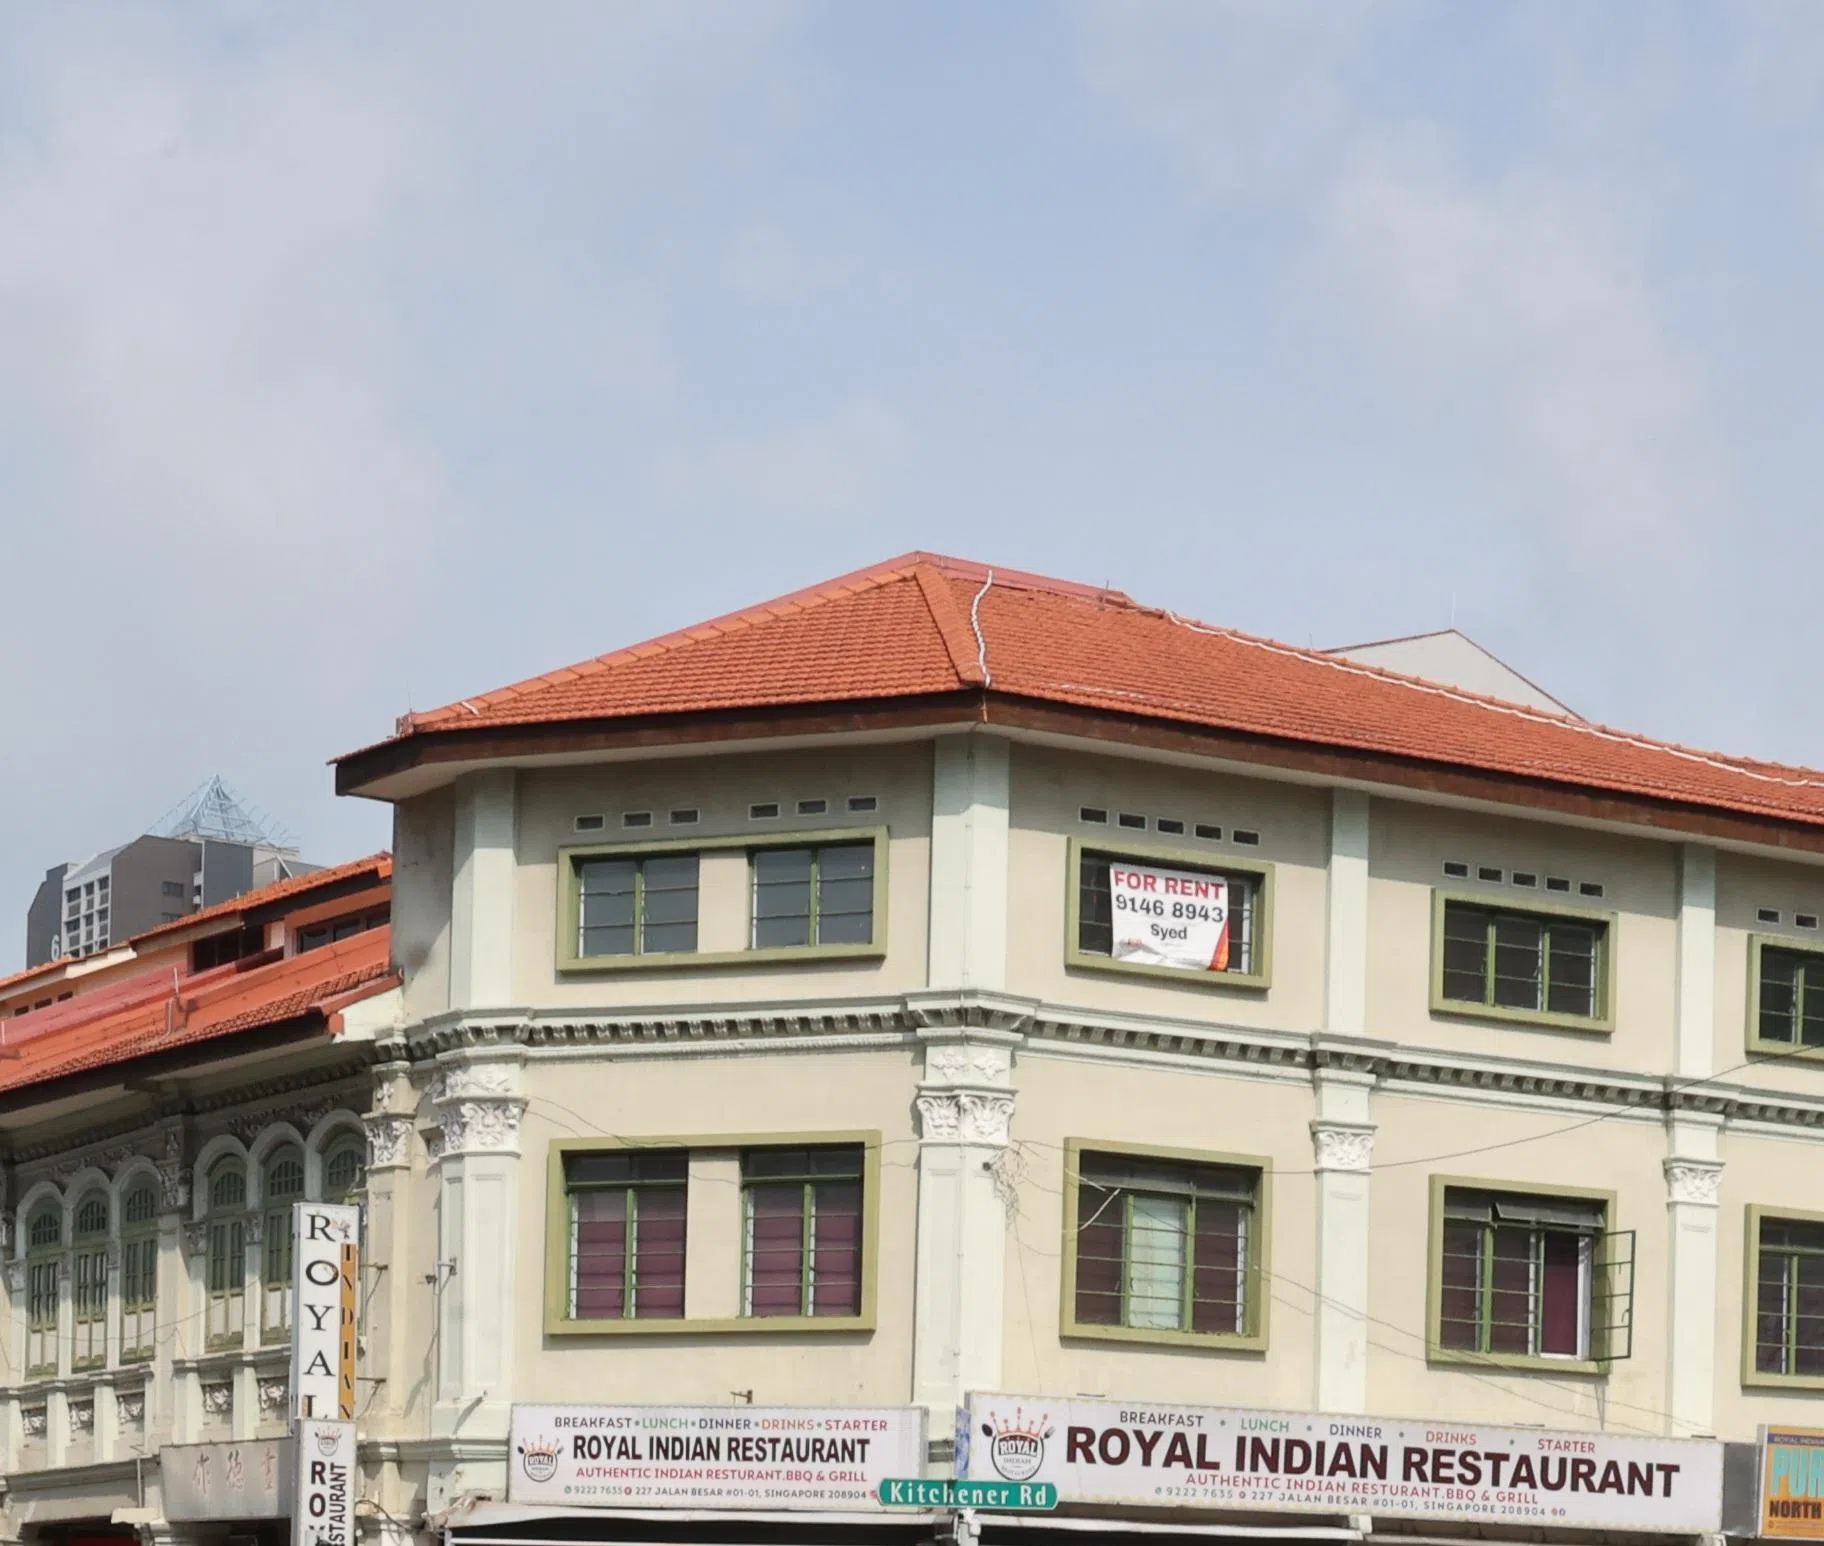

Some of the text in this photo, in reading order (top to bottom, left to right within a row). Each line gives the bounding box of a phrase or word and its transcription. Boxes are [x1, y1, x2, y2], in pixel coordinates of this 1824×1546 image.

[1114, 870, 1224, 899] FOR RENT
[1116, 894, 1223, 923] 9146 8943
[1151, 924, 1187, 941] Syed
[555, 1417, 888, 1431] BREAKFAST LUNCH DINNER DRINKS STARTER
[1120, 1411, 1595, 1453] BREAKFAST LUNCH DINNER DRINKS STARTER
[574, 1435, 870, 1463] ROYAL INDIAN RESTAURANT
[1000, 1440, 1038, 1456] ROYAL
[1067, 1426, 1680, 1497] ROYAL INDIAN RESTAURANT
[576, 1467, 652, 1479] AUTHENTIC
[655, 1468, 703, 1480] INDIAN
[816, 1472, 825, 1481] &
[829, 1471, 867, 1482] GRILL
[1186, 1473, 1281, 1489] AUTHENTIC
[1286, 1479, 1346, 1492] INDIAN
[1481, 1490, 1490, 1501] &
[1496, 1491, 1537, 1504] GRILL
[329, 1462, 347, 1546] STAURANT
[574, 1486, 597, 1494] 9222
[636, 1487, 652, 1495] 227
[655, 1488, 689, 1496] JALAN
[691, 1488, 723, 1497] BESAR
[765, 1488, 825, 1498] SINGAPORE
[829, 1490, 866, 1499] 208904
[890, 1482, 1046, 1505] Kitchener Rd
[1166, 1486, 1197, 1497] 9222
[1203, 1488, 1233, 1498] 7635
[1252, 1491, 1273, 1500] 227
[1278, 1492, 1322, 1503] JALAN
[1328, 1496, 1367, 1506] BESAR
[1424, 1500, 1495, 1514] SINGAPORE
[1501, 1505, 1545, 1516] 208904
[1769, 1500, 1821, 1519] NORTH
